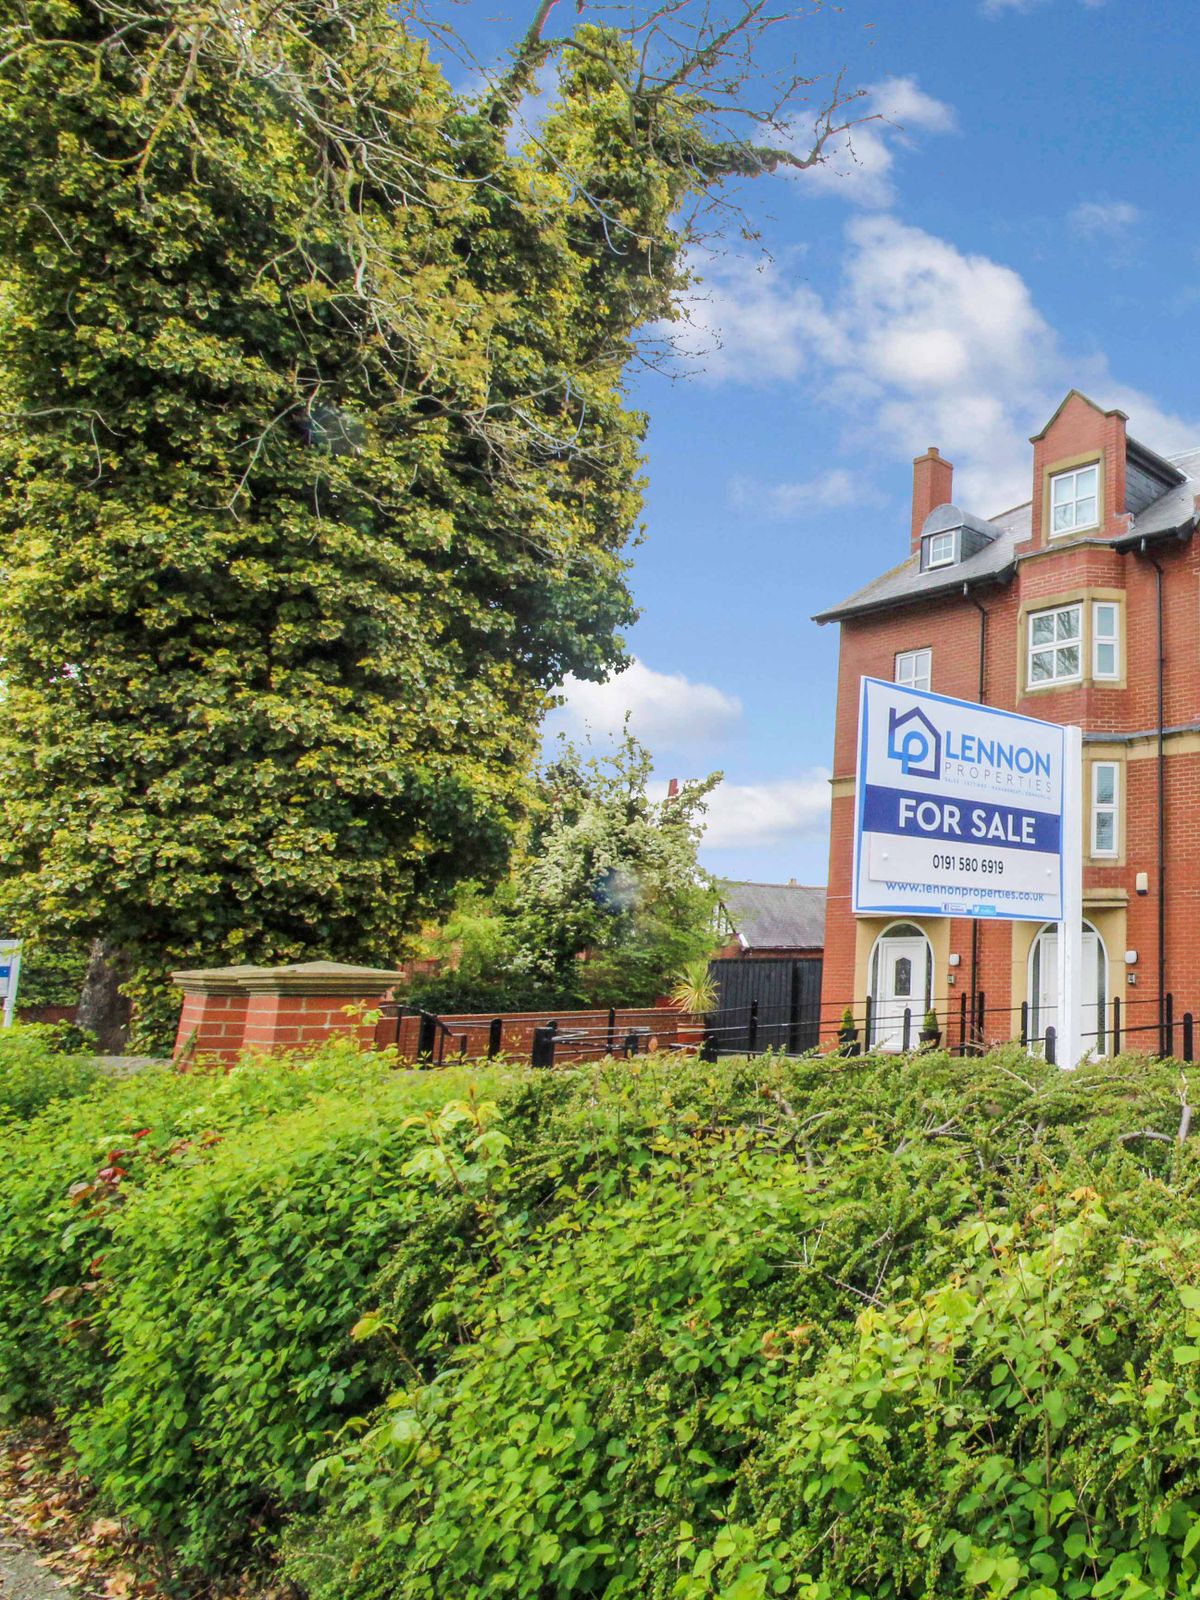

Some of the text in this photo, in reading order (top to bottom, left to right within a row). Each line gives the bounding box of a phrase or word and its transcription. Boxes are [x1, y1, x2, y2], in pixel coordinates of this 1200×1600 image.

[945, 731, 1050, 778] LENNON
[944, 762, 1052, 793] PROPERTIES
[899, 797, 1036, 844] FOR SALE
[932, 854, 1004, 874] 0191 580 6919
[885, 881, 1045, 902] www.lennonproperties.co.uk
